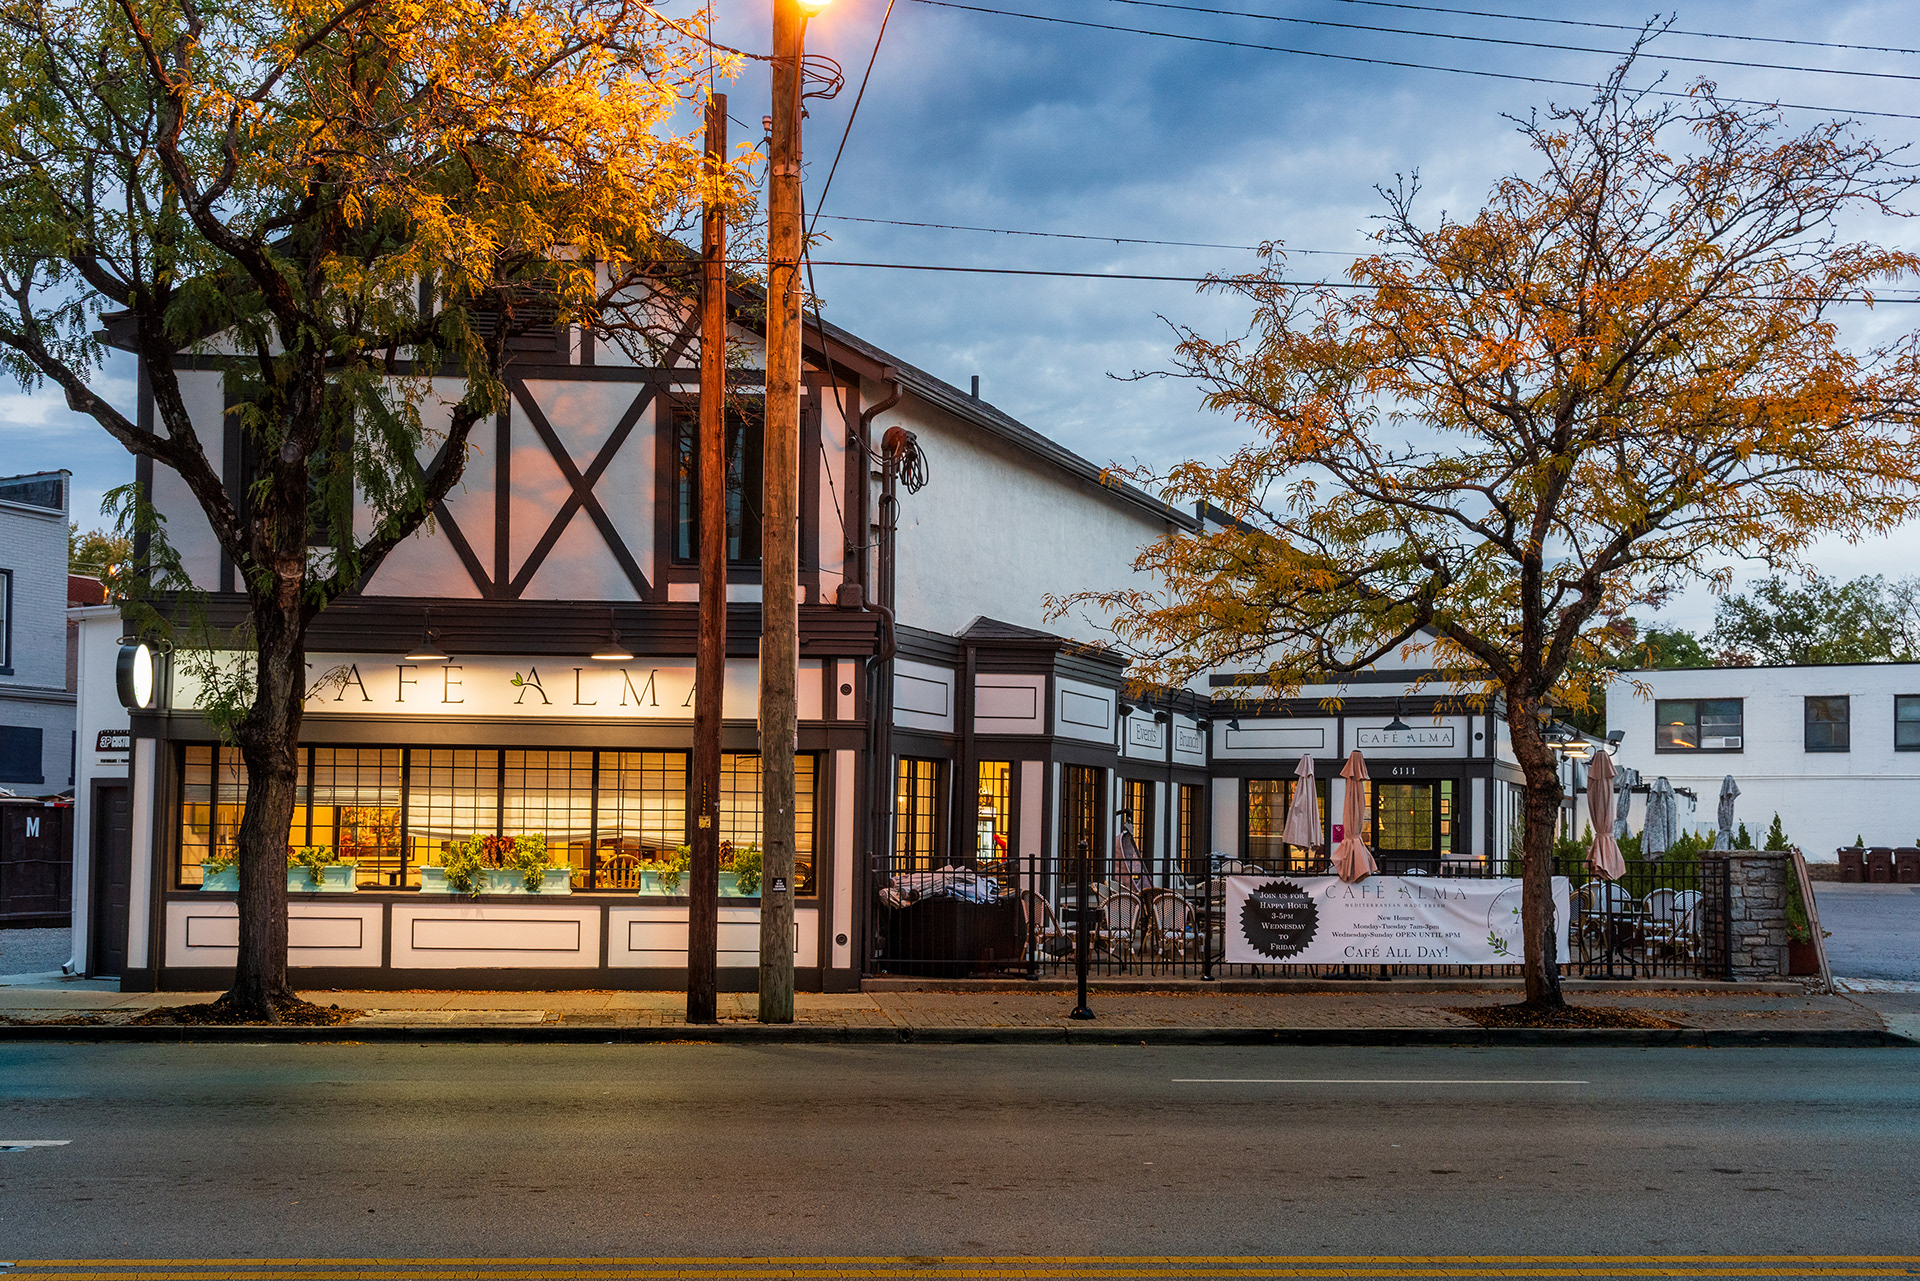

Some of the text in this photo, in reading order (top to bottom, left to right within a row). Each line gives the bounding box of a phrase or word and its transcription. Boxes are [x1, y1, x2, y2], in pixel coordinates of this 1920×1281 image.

[305, 657, 464, 704] AFÉ
[1136, 724, 1156, 742] Events
[1179, 731, 1199, 749] Brunch
[1360, 731, 1451, 743] CAFÉ ALMA
[1392, 767, 1416, 775] 6111
[26, 816, 40, 838] M
[1325, 881, 1467, 900] CAFÉ ALMA
[1353, 923, 1407, 931] Monday-Tuesday
